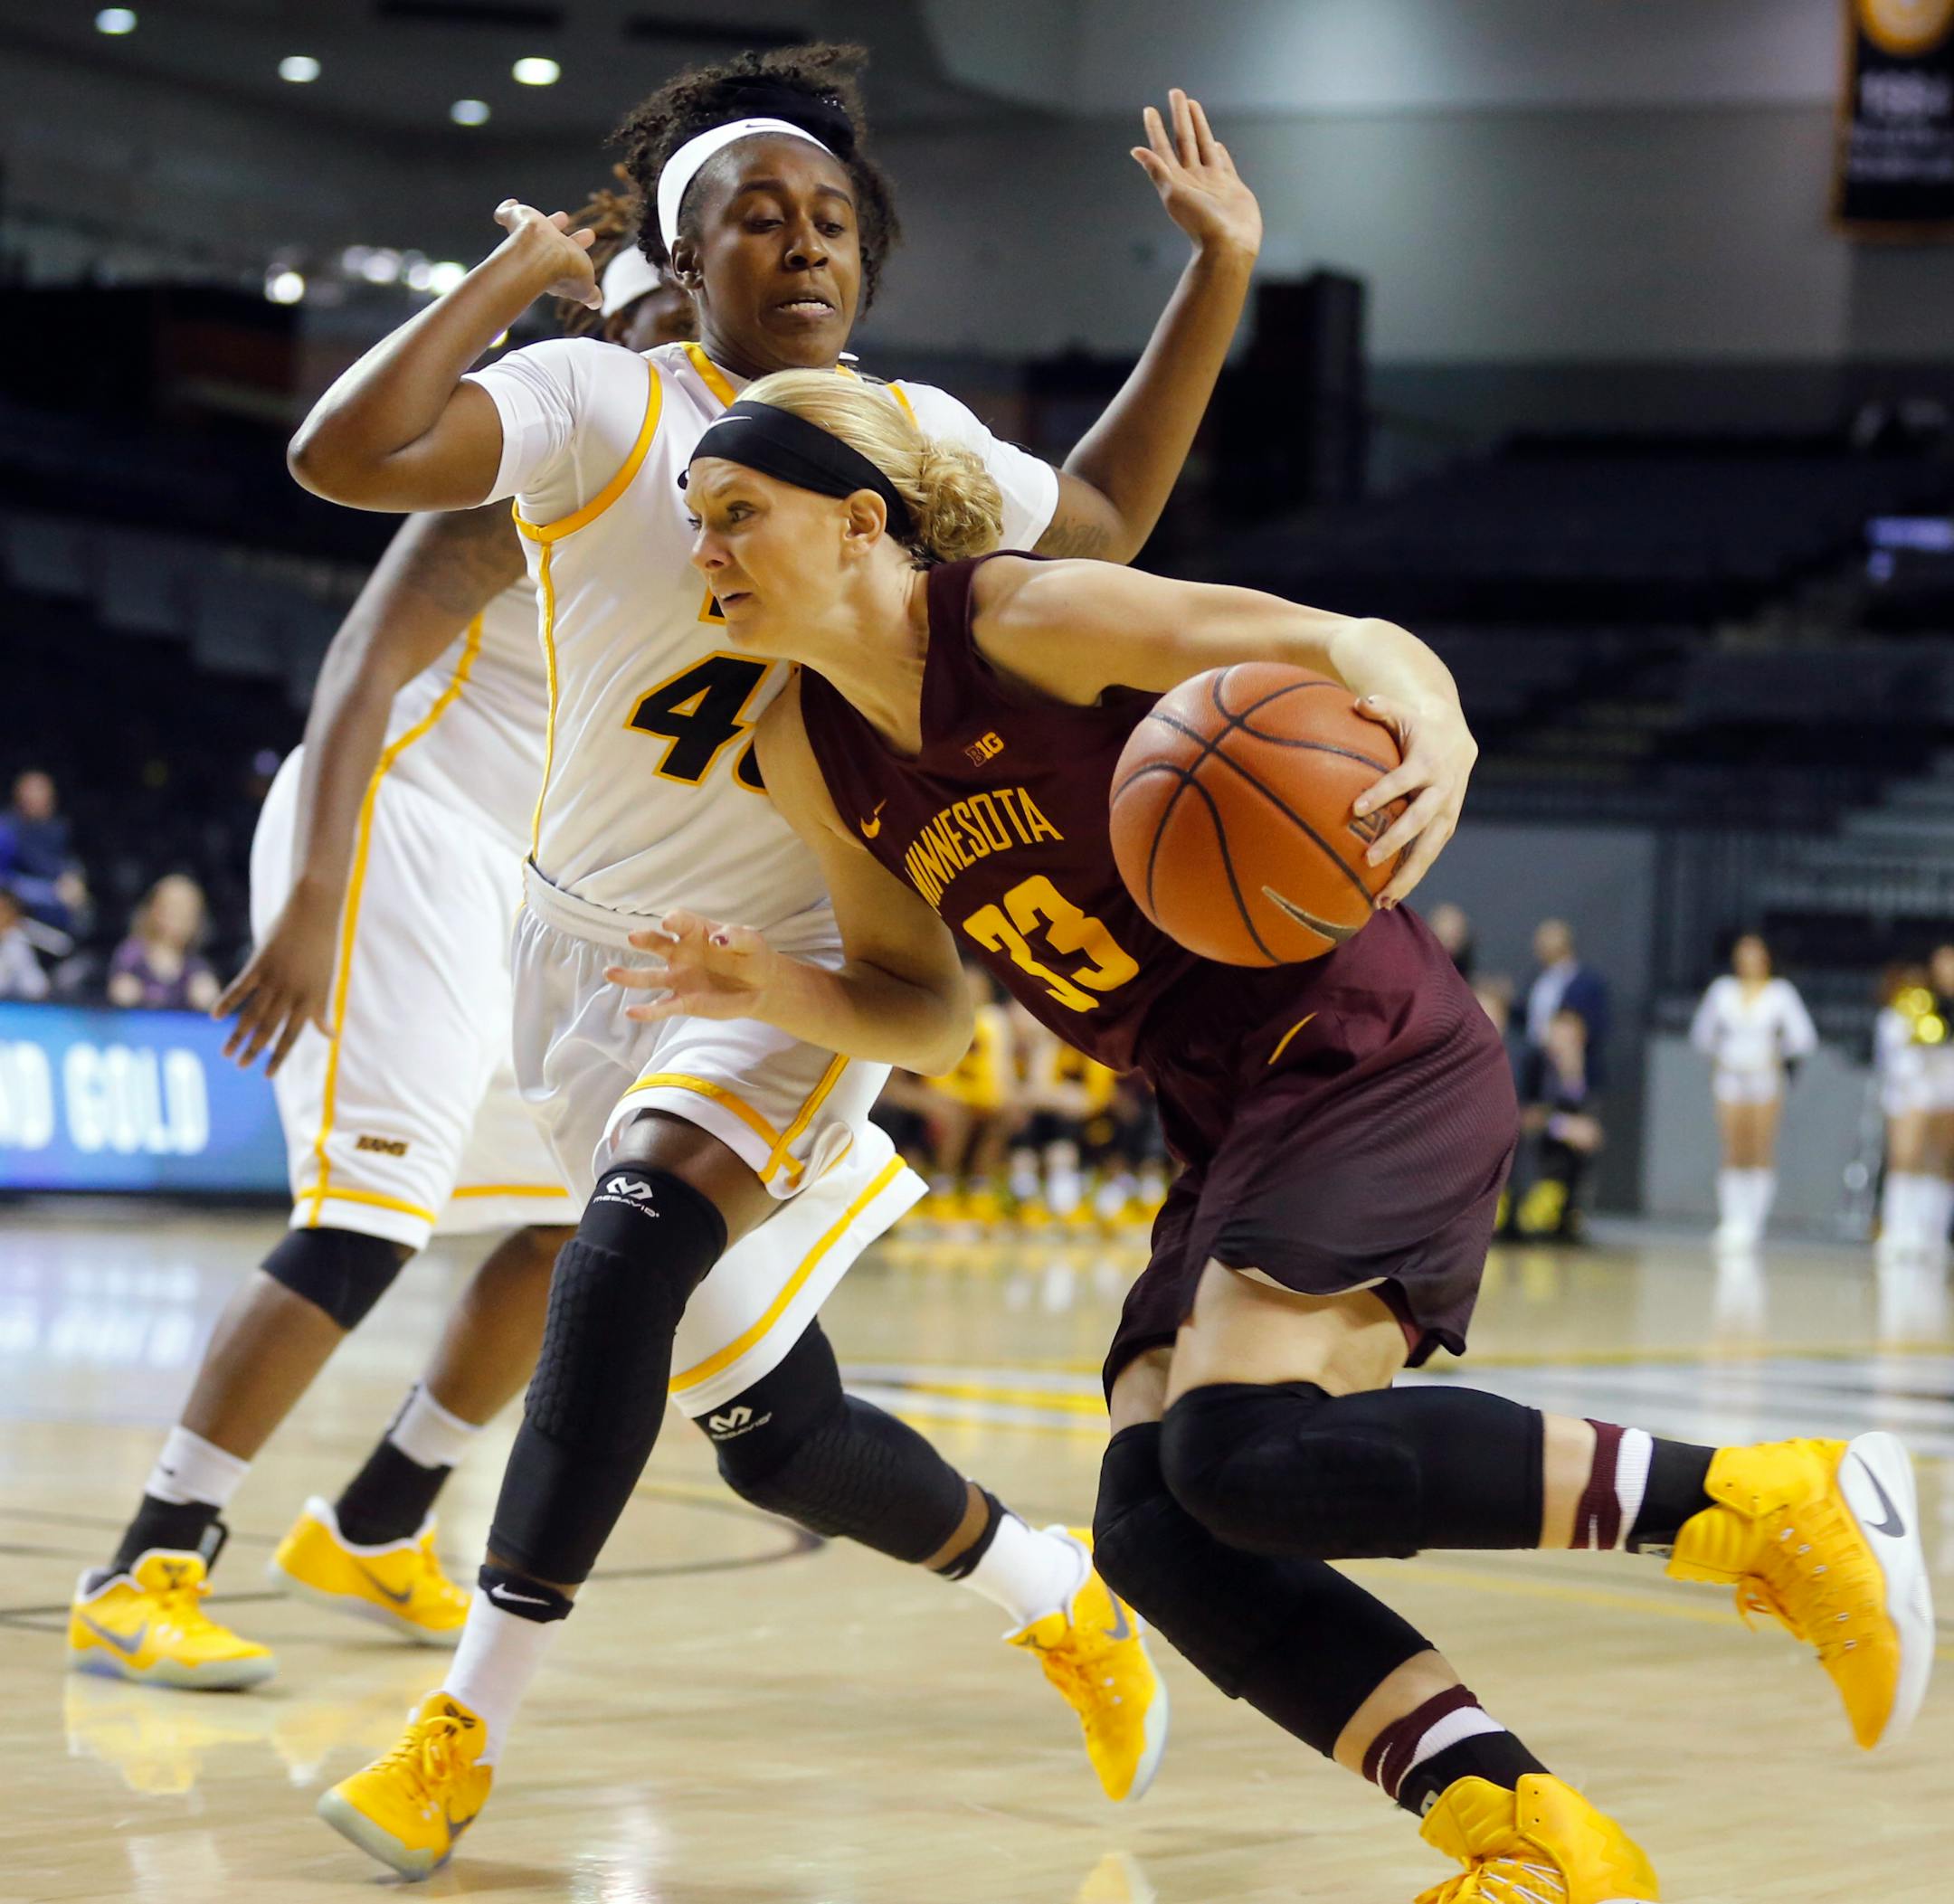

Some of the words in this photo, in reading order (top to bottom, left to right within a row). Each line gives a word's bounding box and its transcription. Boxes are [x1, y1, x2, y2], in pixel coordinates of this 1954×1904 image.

[622, 649, 771, 796] 4
[905, 787, 1065, 916] MINNESOTA
[962, 874, 1141, 1013] 33
